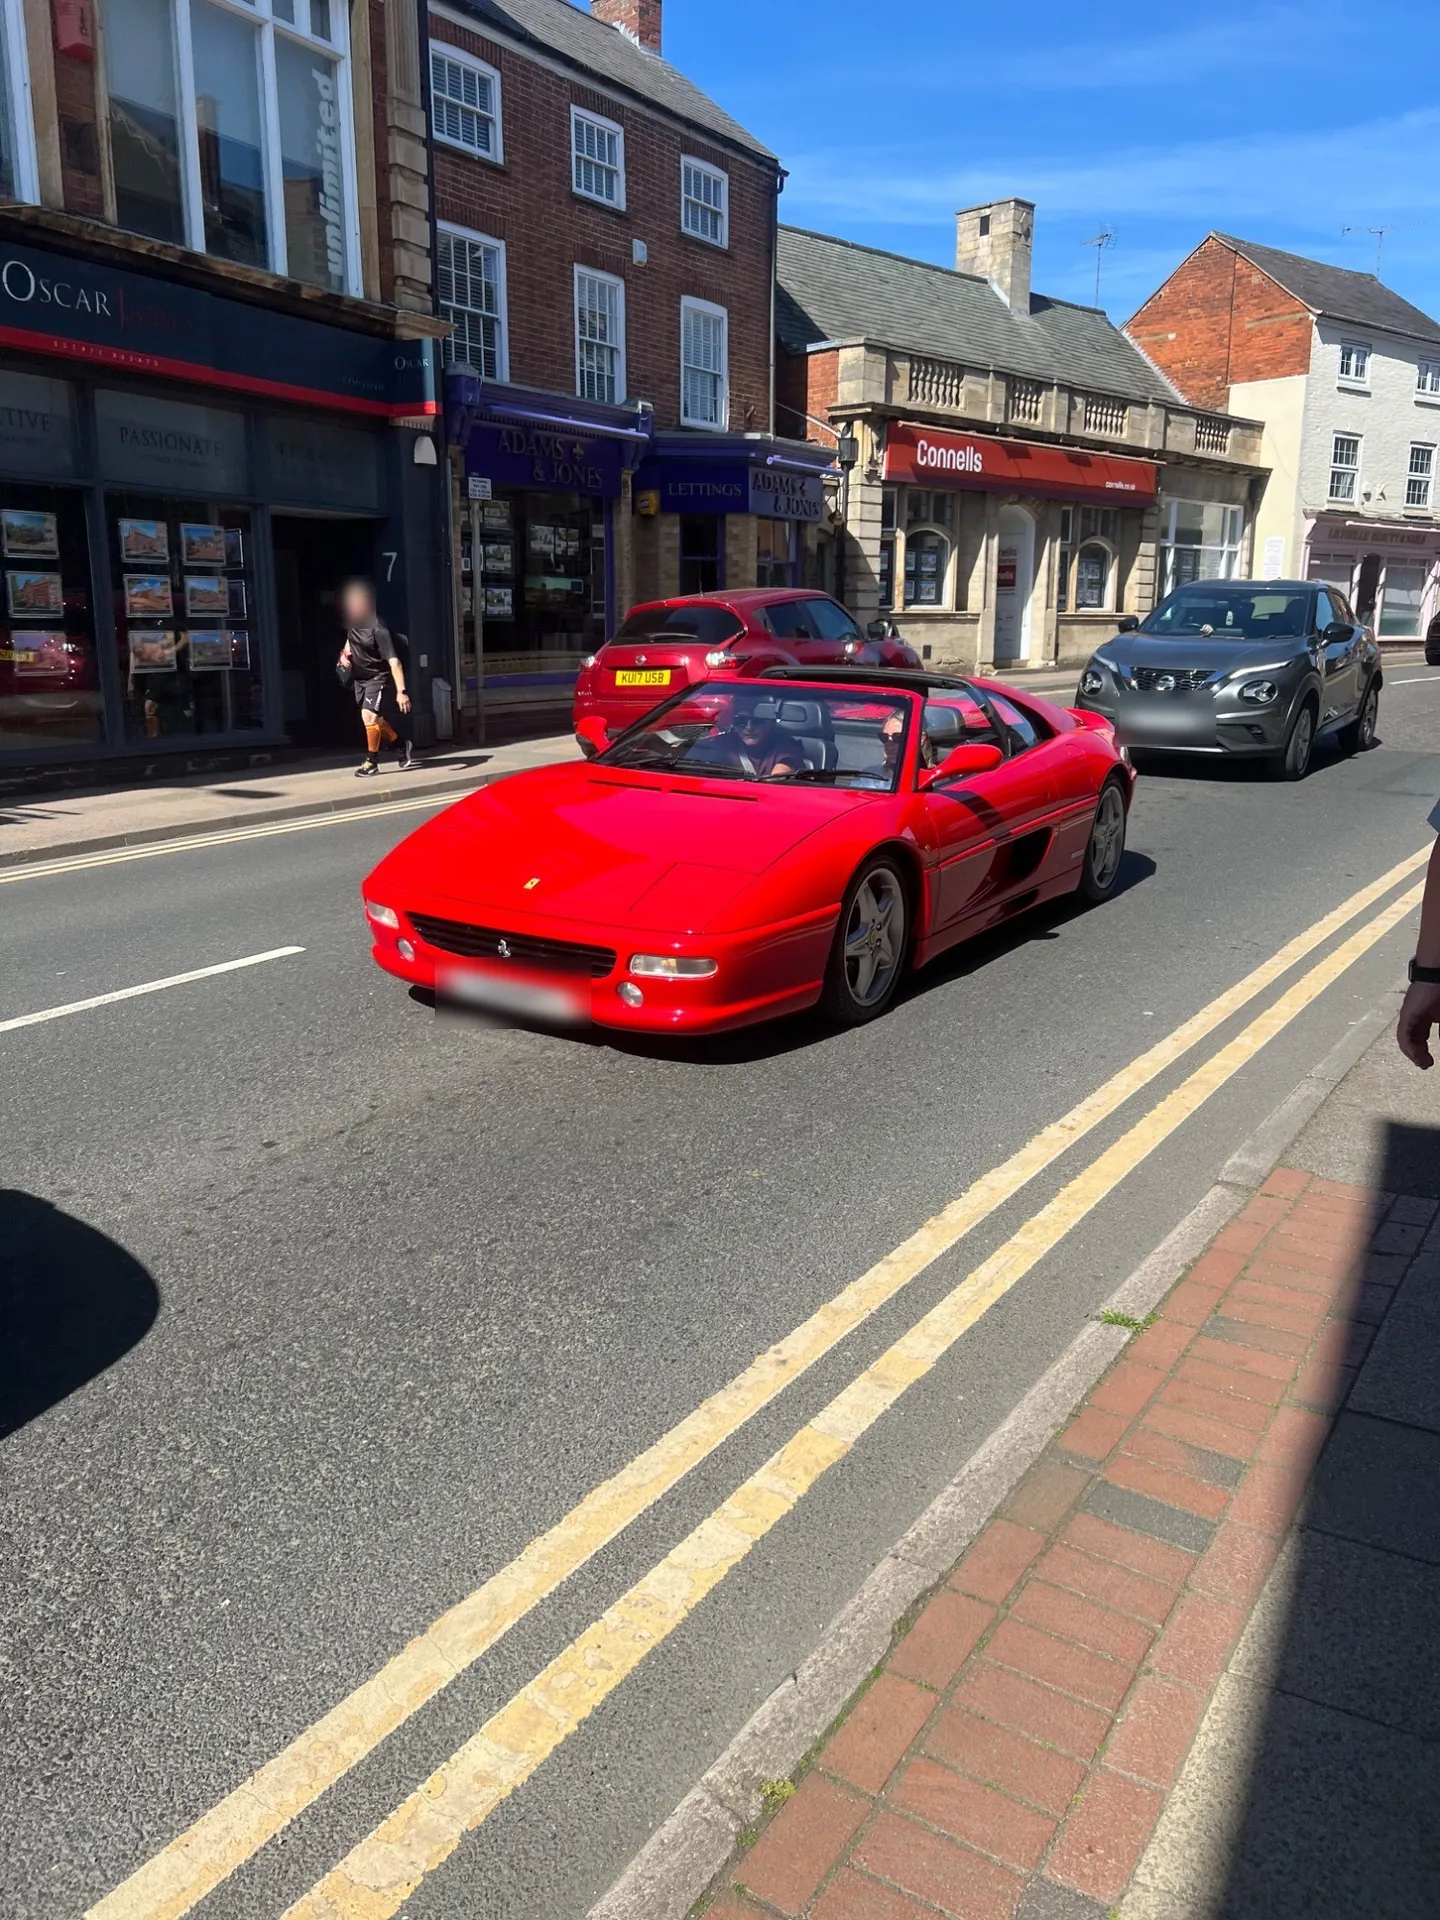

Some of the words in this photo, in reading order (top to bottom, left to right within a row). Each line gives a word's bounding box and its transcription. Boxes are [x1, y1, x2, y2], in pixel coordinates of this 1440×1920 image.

[2, 260, 112, 317] OSCAR
[0, 406, 51, 432] TIVE
[120, 425, 222, 457] PASSIONATE
[497, 429, 565, 460] ADAMS
[917, 439, 983, 473] Connells
[533, 459, 546, 482] &
[548, 461, 604, 489] JONES
[668, 482, 742, 497] LETTINGS
[382, 551, 397, 582] 7
[622, 673, 643, 684] KU17
[645, 672, 664, 684] USB
